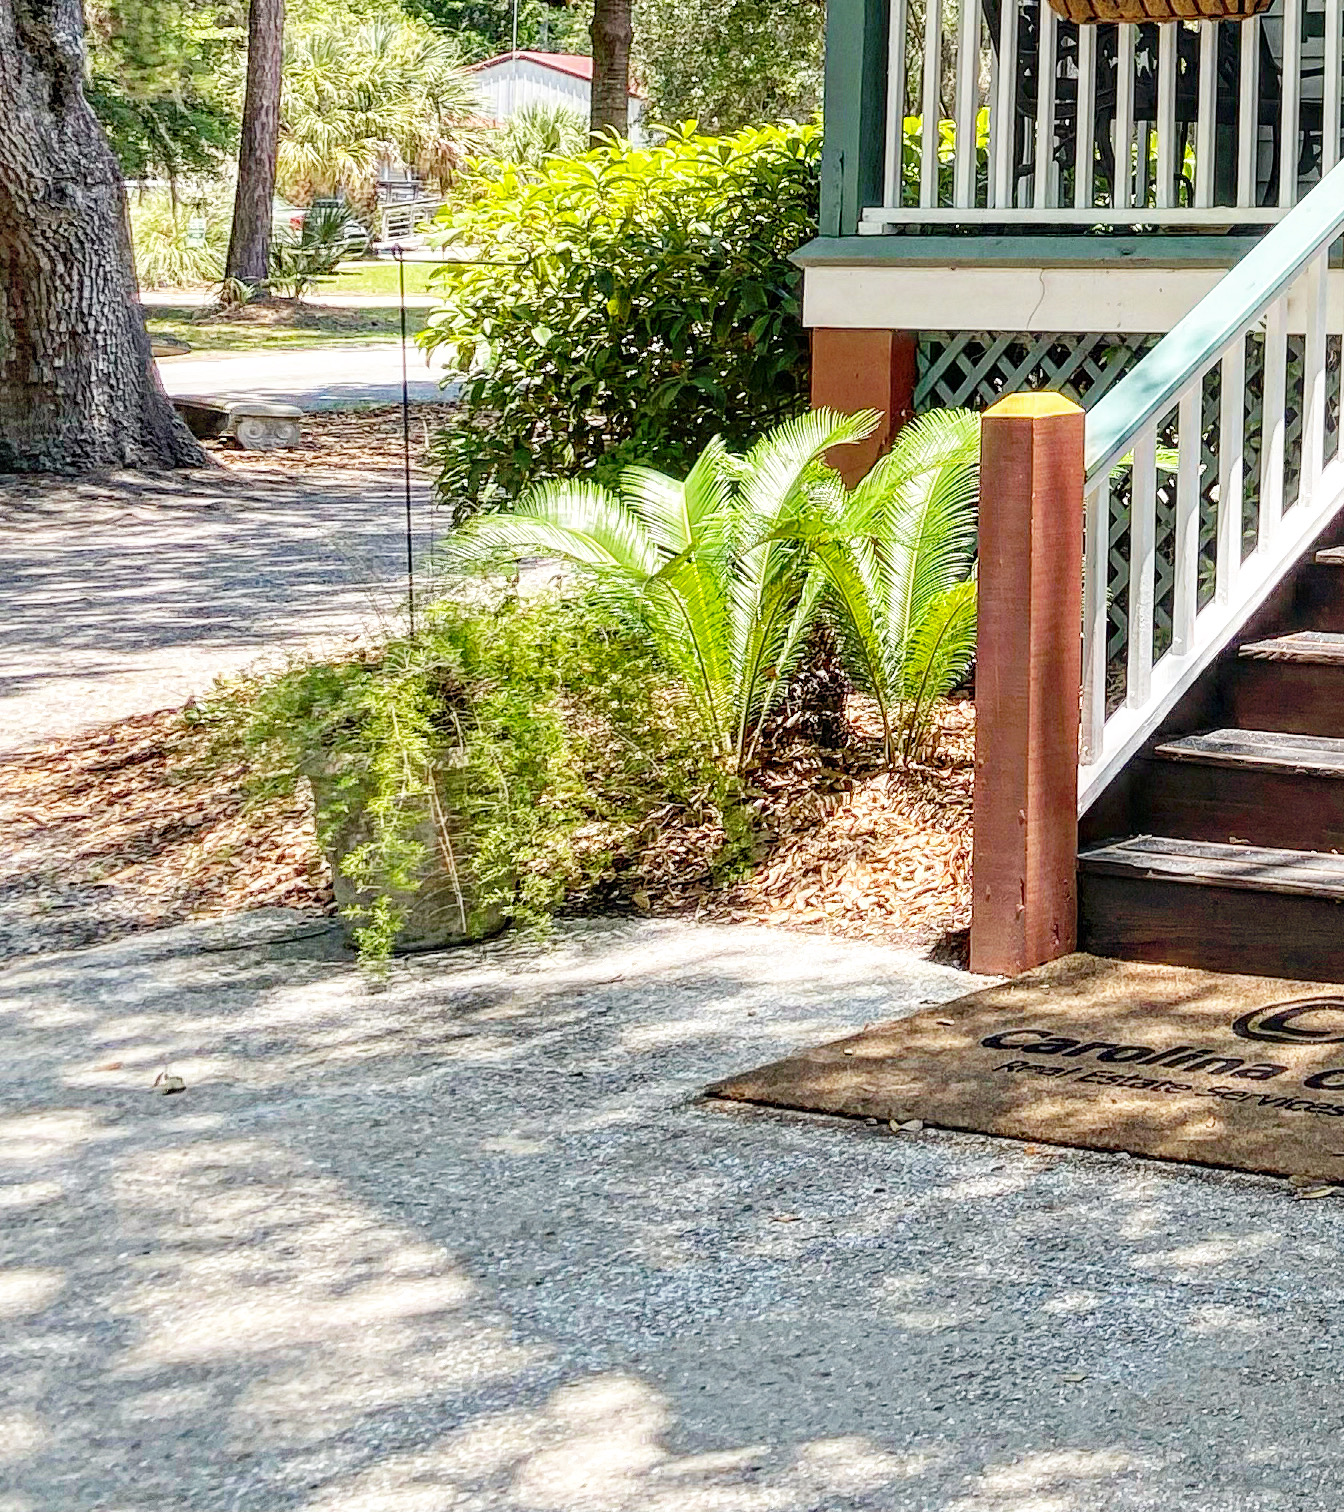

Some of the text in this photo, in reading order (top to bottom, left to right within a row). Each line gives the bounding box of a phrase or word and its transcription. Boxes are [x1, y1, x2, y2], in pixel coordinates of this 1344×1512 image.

[981, 1029, 1290, 1081] Carolina
[992, 1060, 1084, 1079] Real
[1074, 1070, 1194, 1094] Estate
